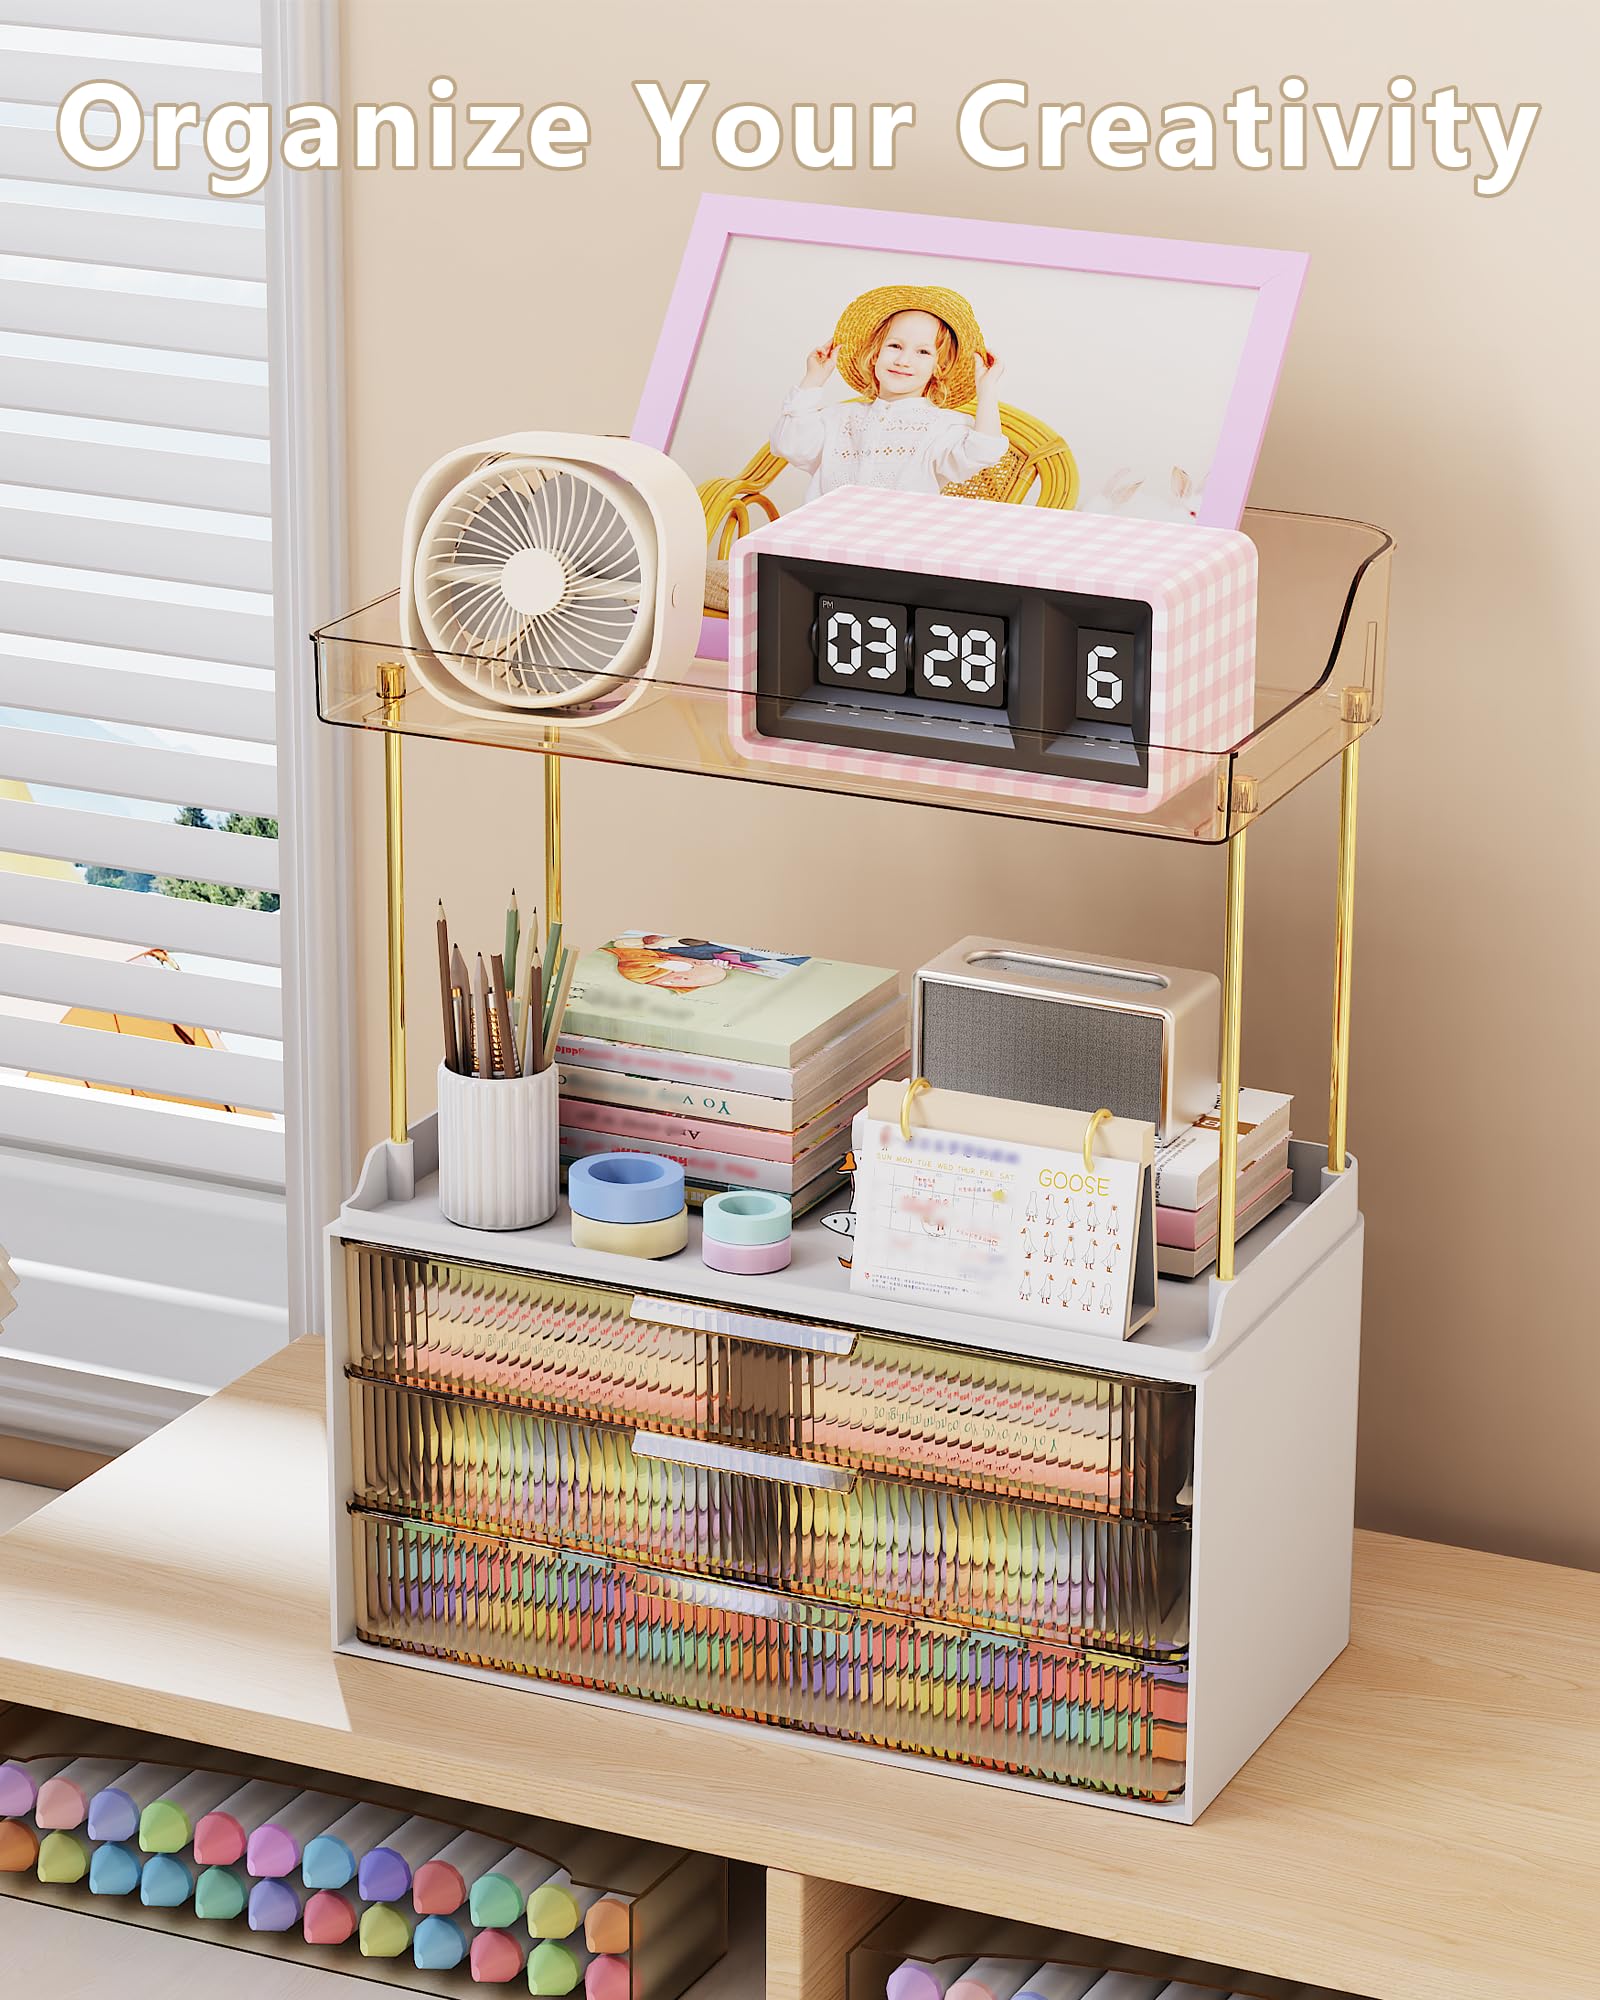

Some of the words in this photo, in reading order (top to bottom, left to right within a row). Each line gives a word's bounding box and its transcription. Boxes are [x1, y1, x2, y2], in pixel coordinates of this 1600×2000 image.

[822, 600, 835, 610] PM
[827, 611, 897, 680] 03
[923, 623, 997, 693] 28
[1086, 645, 1123, 709] 6
[876, 1152, 892, 1161] SUN
[895, 1155, 913, 1164] MON
[917, 1159, 932, 1168] TUE
[937, 1161, 954, 1171] WED
[999, 1171, 1016, 1180] SAT
[1039, 1168, 1111, 1197] GOOSE
